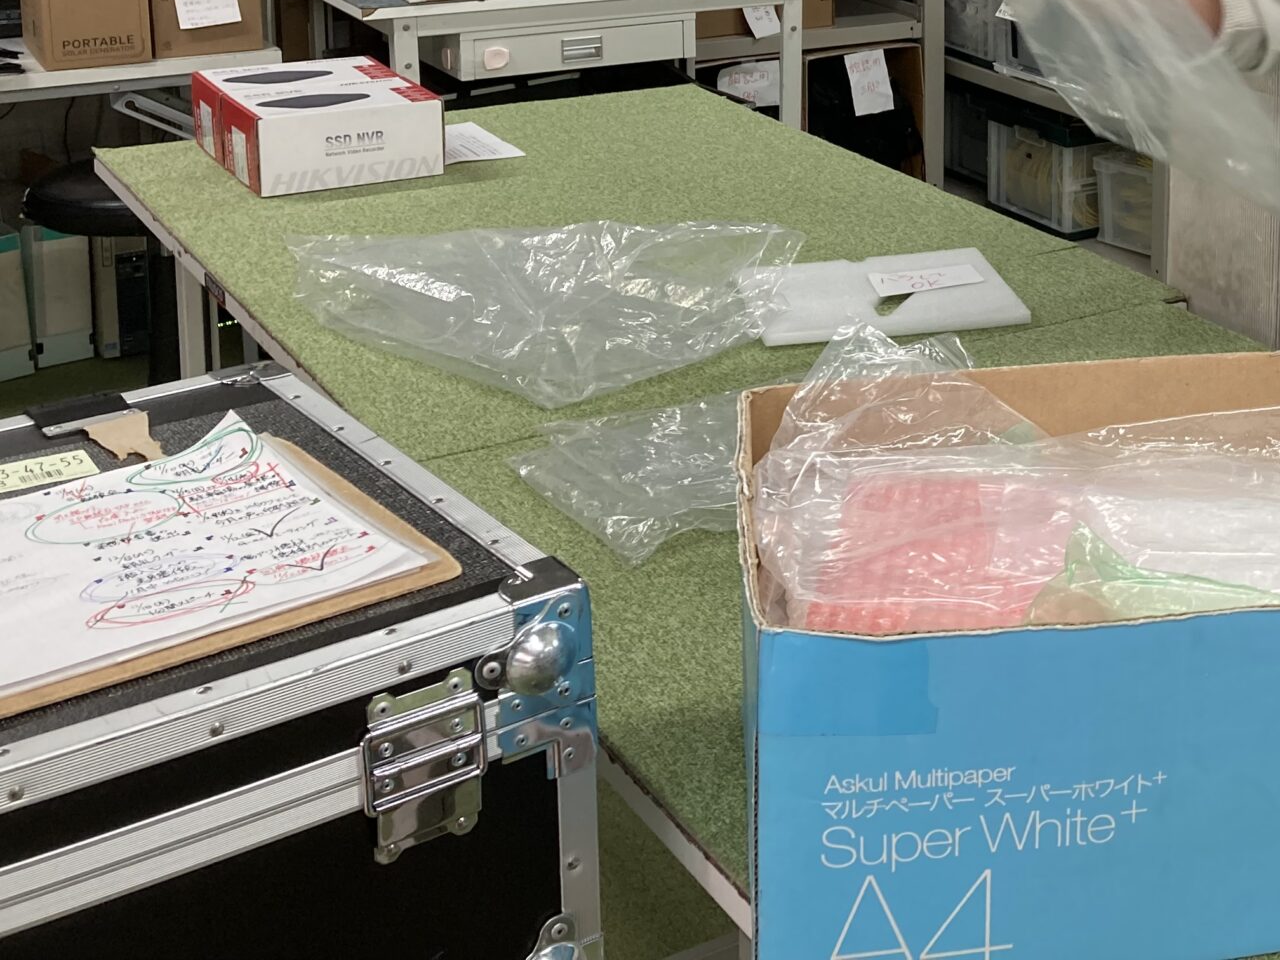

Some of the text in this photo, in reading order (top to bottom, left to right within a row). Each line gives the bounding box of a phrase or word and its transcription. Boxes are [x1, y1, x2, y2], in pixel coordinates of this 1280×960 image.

[62, 34, 135, 50] PORTABLE
[325, 130, 384, 148] SSD NVR
[269, 154, 440, 195] HIKVISION
[823, 766, 1016, 795] Askul Multipaper
[820, 795, 975, 820] マルチペーパー
[820, 825, 972, 873] Super
[830, 868, 1014, 960] A4
